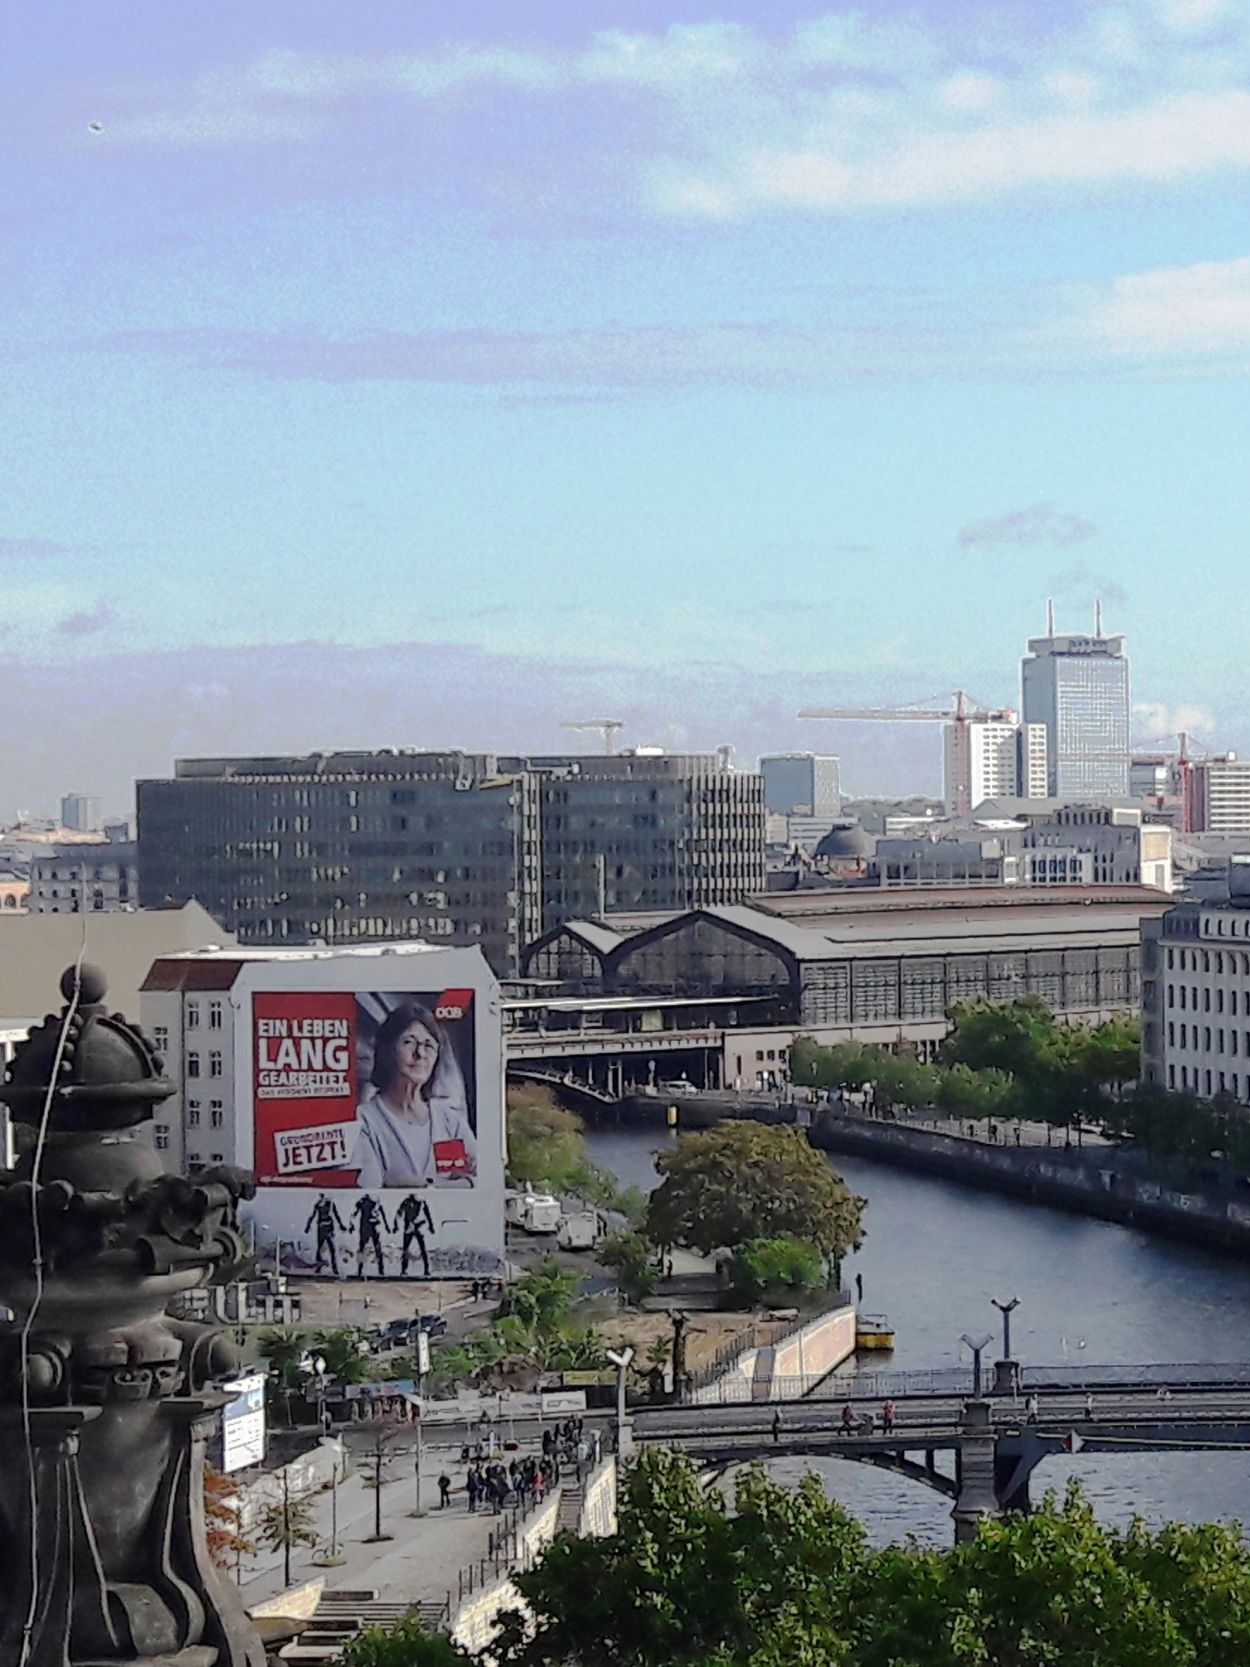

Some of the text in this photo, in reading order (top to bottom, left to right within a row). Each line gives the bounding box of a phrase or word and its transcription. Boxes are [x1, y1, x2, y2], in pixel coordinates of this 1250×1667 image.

[259, 1018, 348, 1037] EIN LEBEN
[259, 1038, 349, 1071] LANG
[282, 1139, 347, 1168] JETZT!
